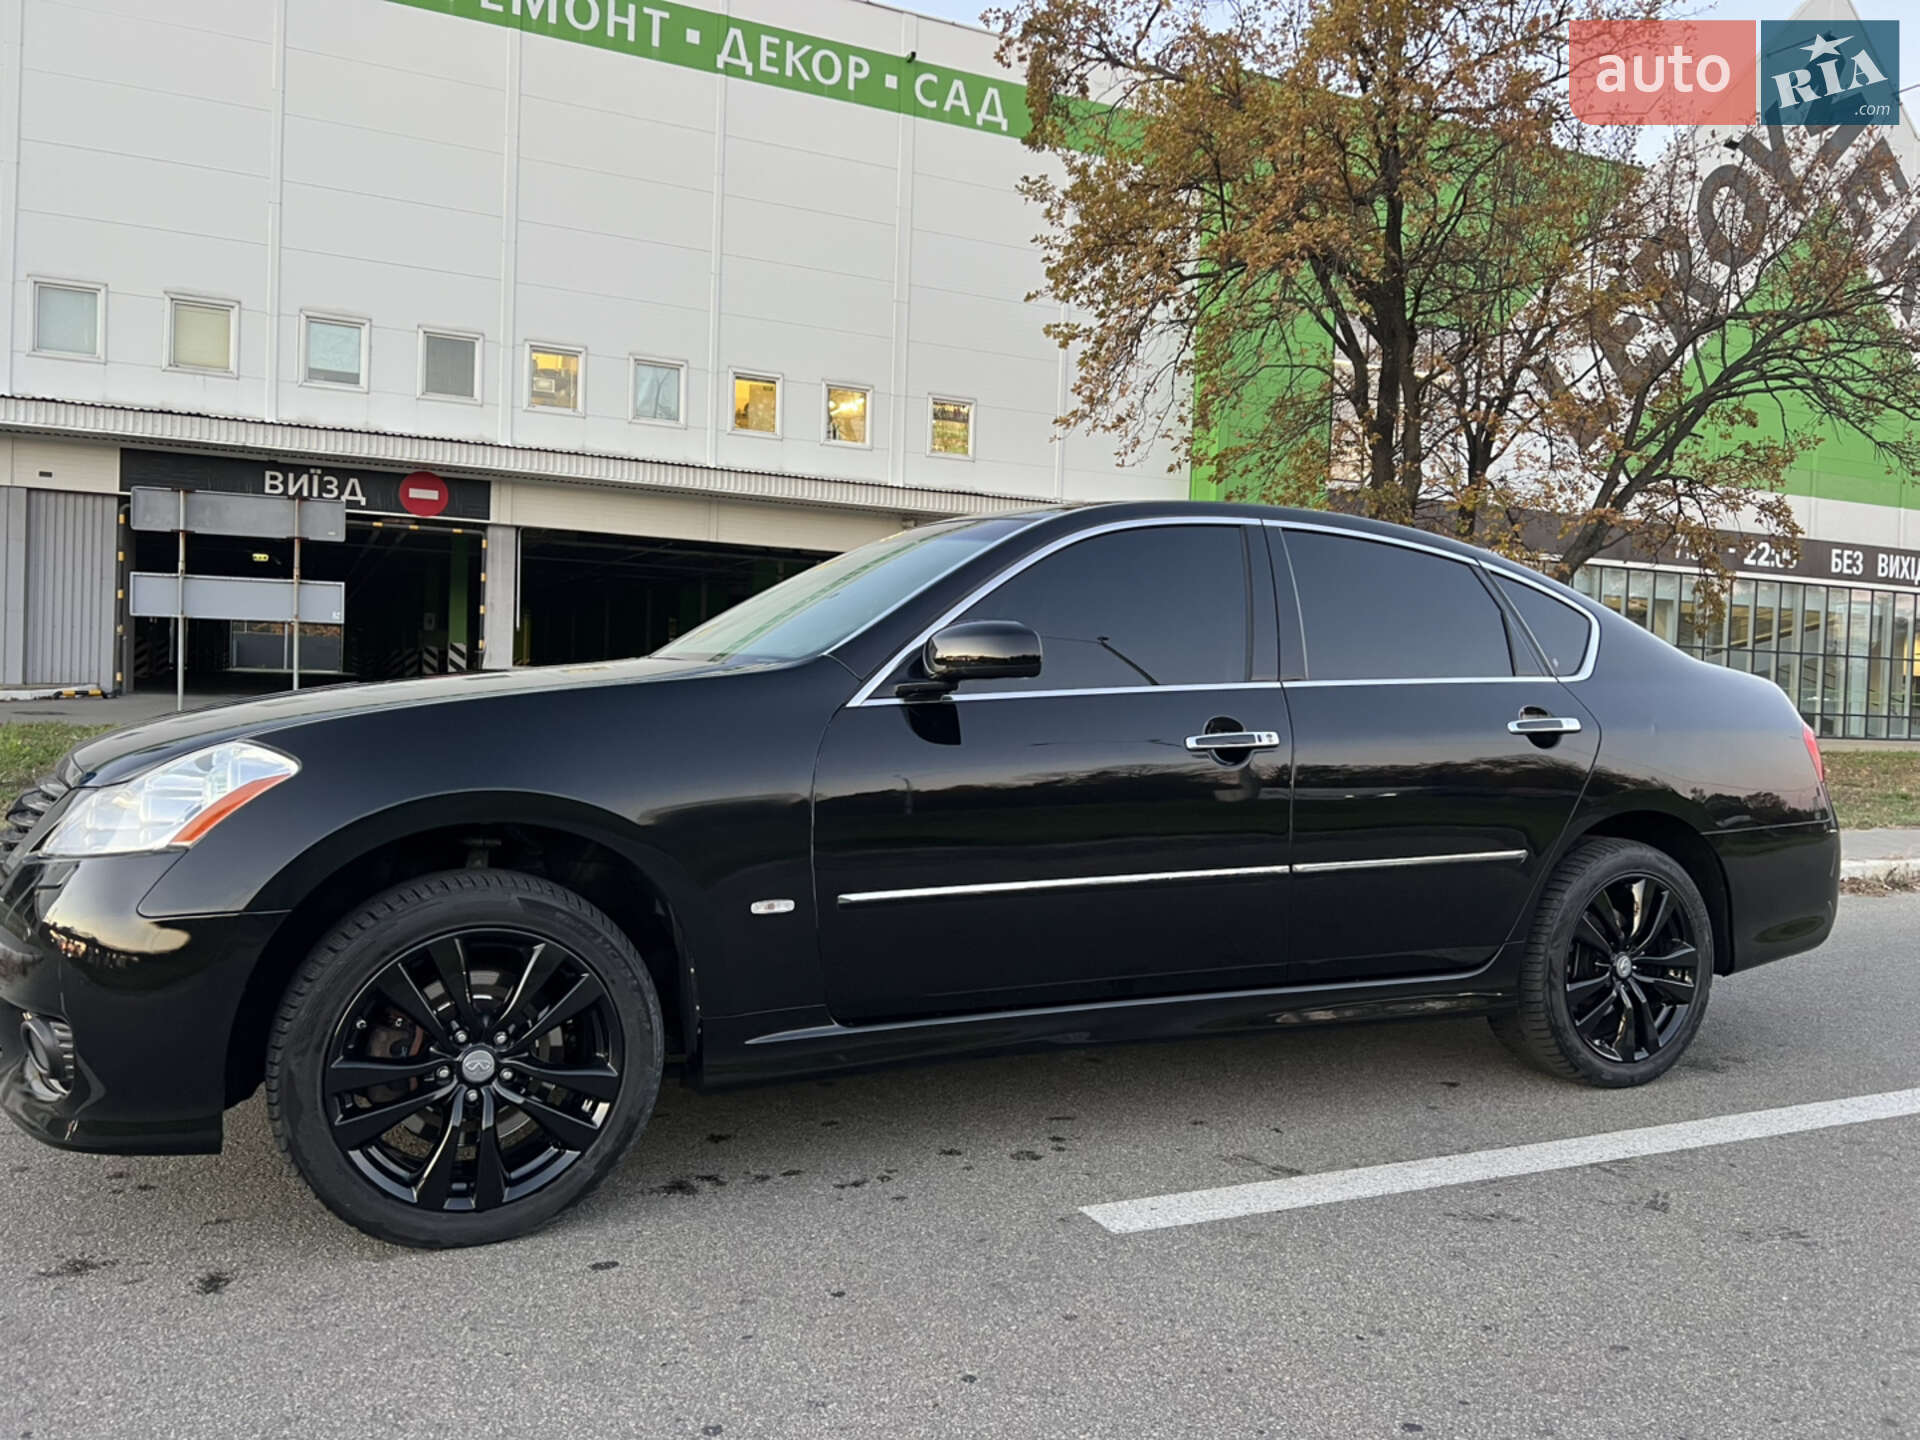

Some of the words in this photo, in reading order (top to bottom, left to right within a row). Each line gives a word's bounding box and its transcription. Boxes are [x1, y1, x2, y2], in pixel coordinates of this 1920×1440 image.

[716, 27, 870, 91] ДЕКОР
[914, 73, 1008, 131] САД
[264, 468, 366, 506] ВИЇЗД
[1831, 548, 1864, 576] БЕЗ
